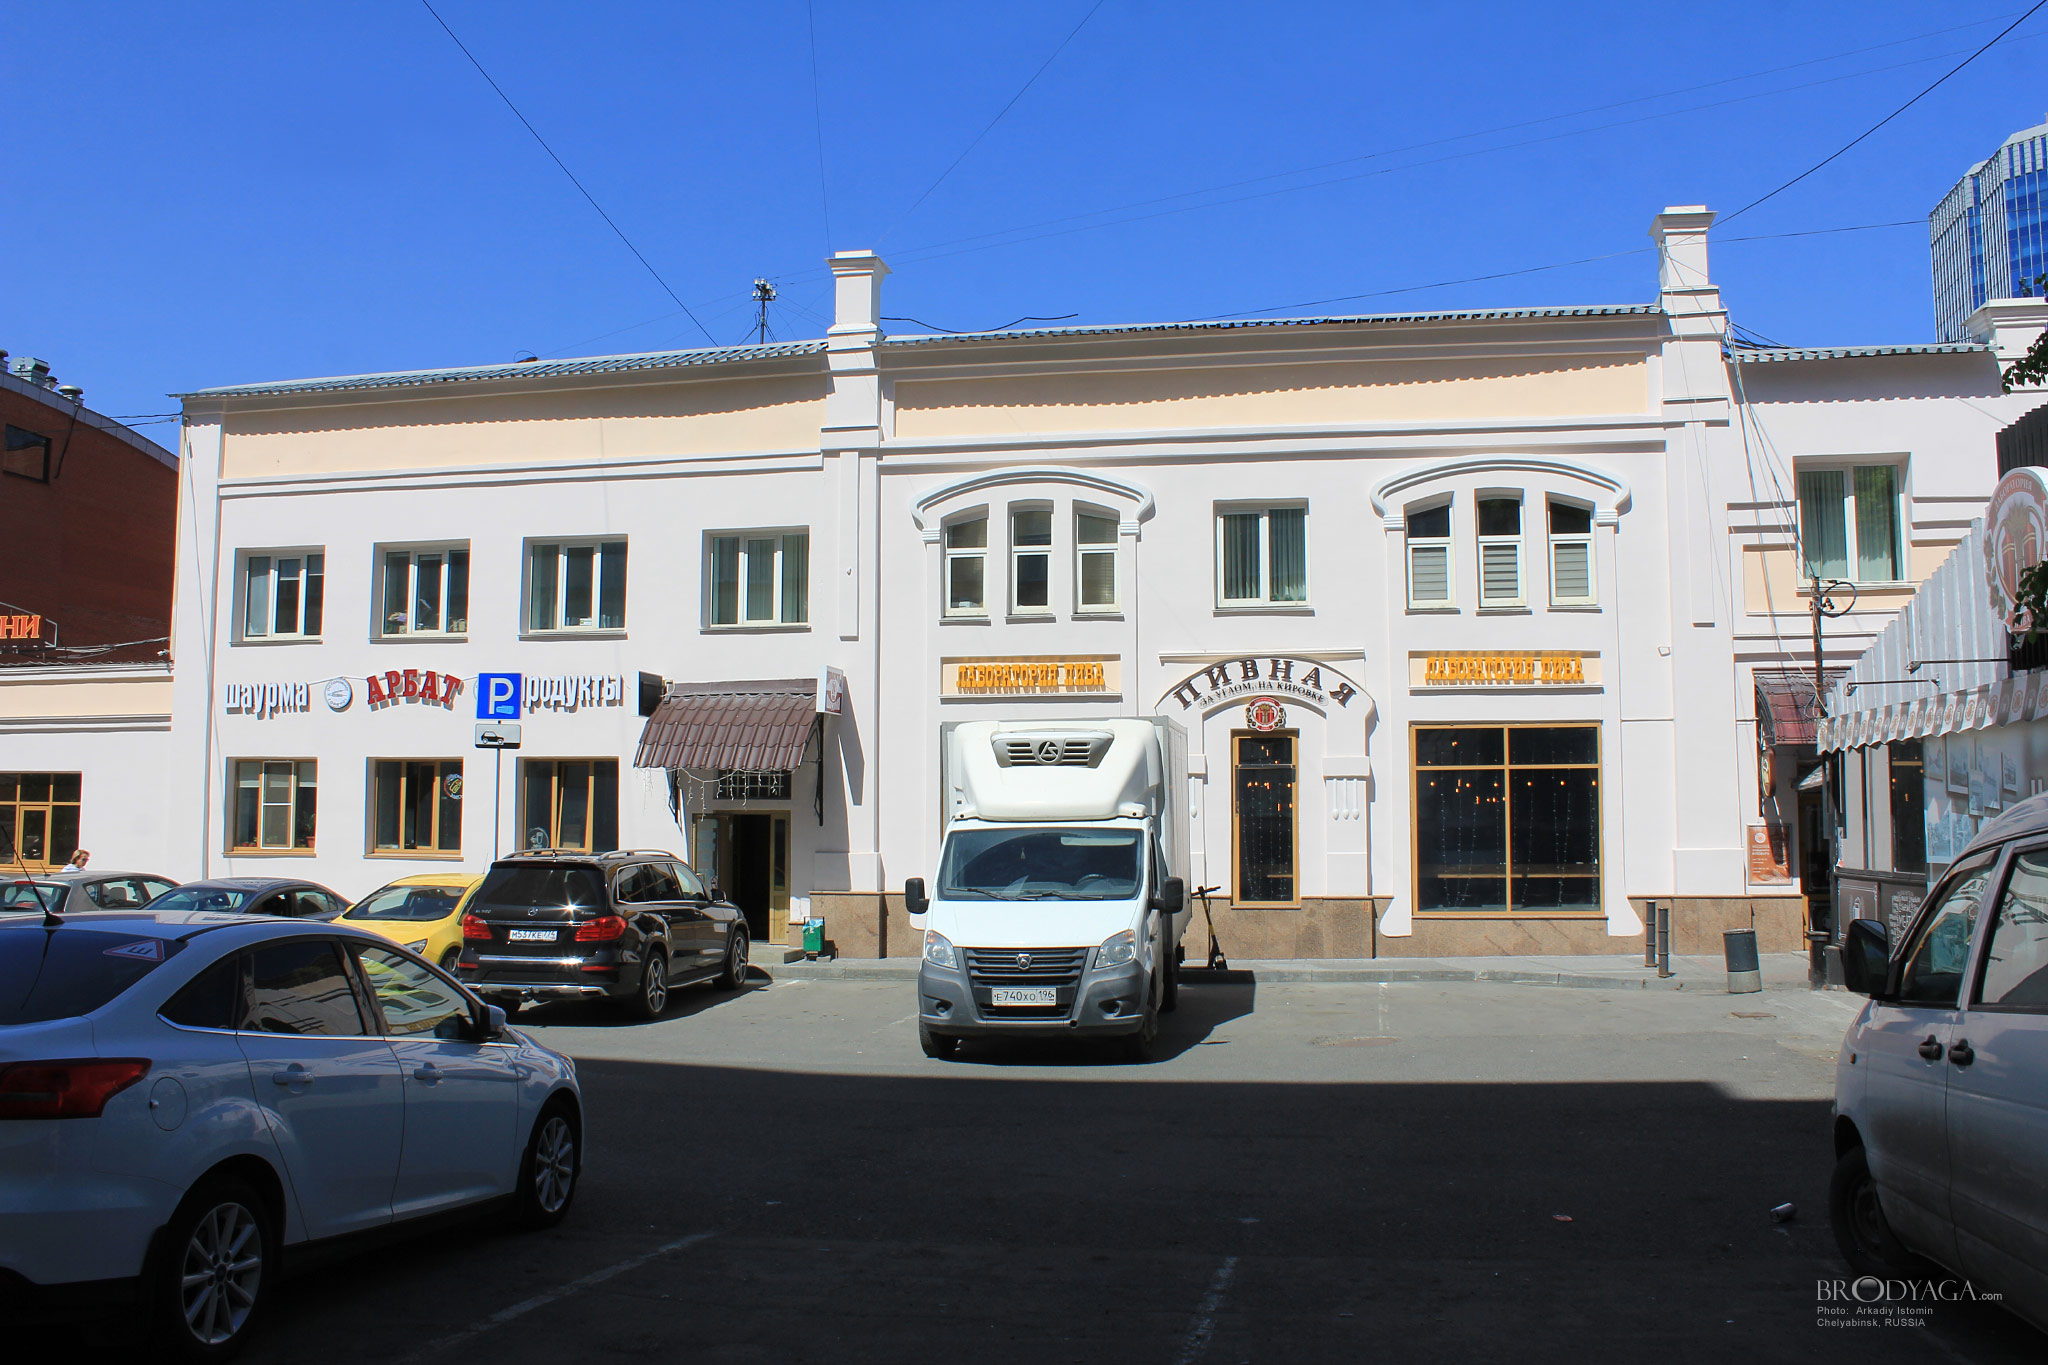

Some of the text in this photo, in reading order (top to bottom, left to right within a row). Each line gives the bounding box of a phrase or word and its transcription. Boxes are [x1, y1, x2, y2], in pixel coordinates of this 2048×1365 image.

[956, 662, 1105, 688] ЛАБОРАТОРИЯ ПИВА
[1173, 659, 1357, 710] ПИВНАЯ
[1425, 656, 1584, 681] ЛАБОРАТОРИЯ ПИВА
[367, 668, 463, 705] АРБАТ
[488, 677, 514, 715] P
[523, 674, 622, 708] родукты
[1200, 695, 1214, 706] ЗА
[1258, 681, 1273, 690] НА
[1277, 681, 1326, 703] КИРОВКЕ
